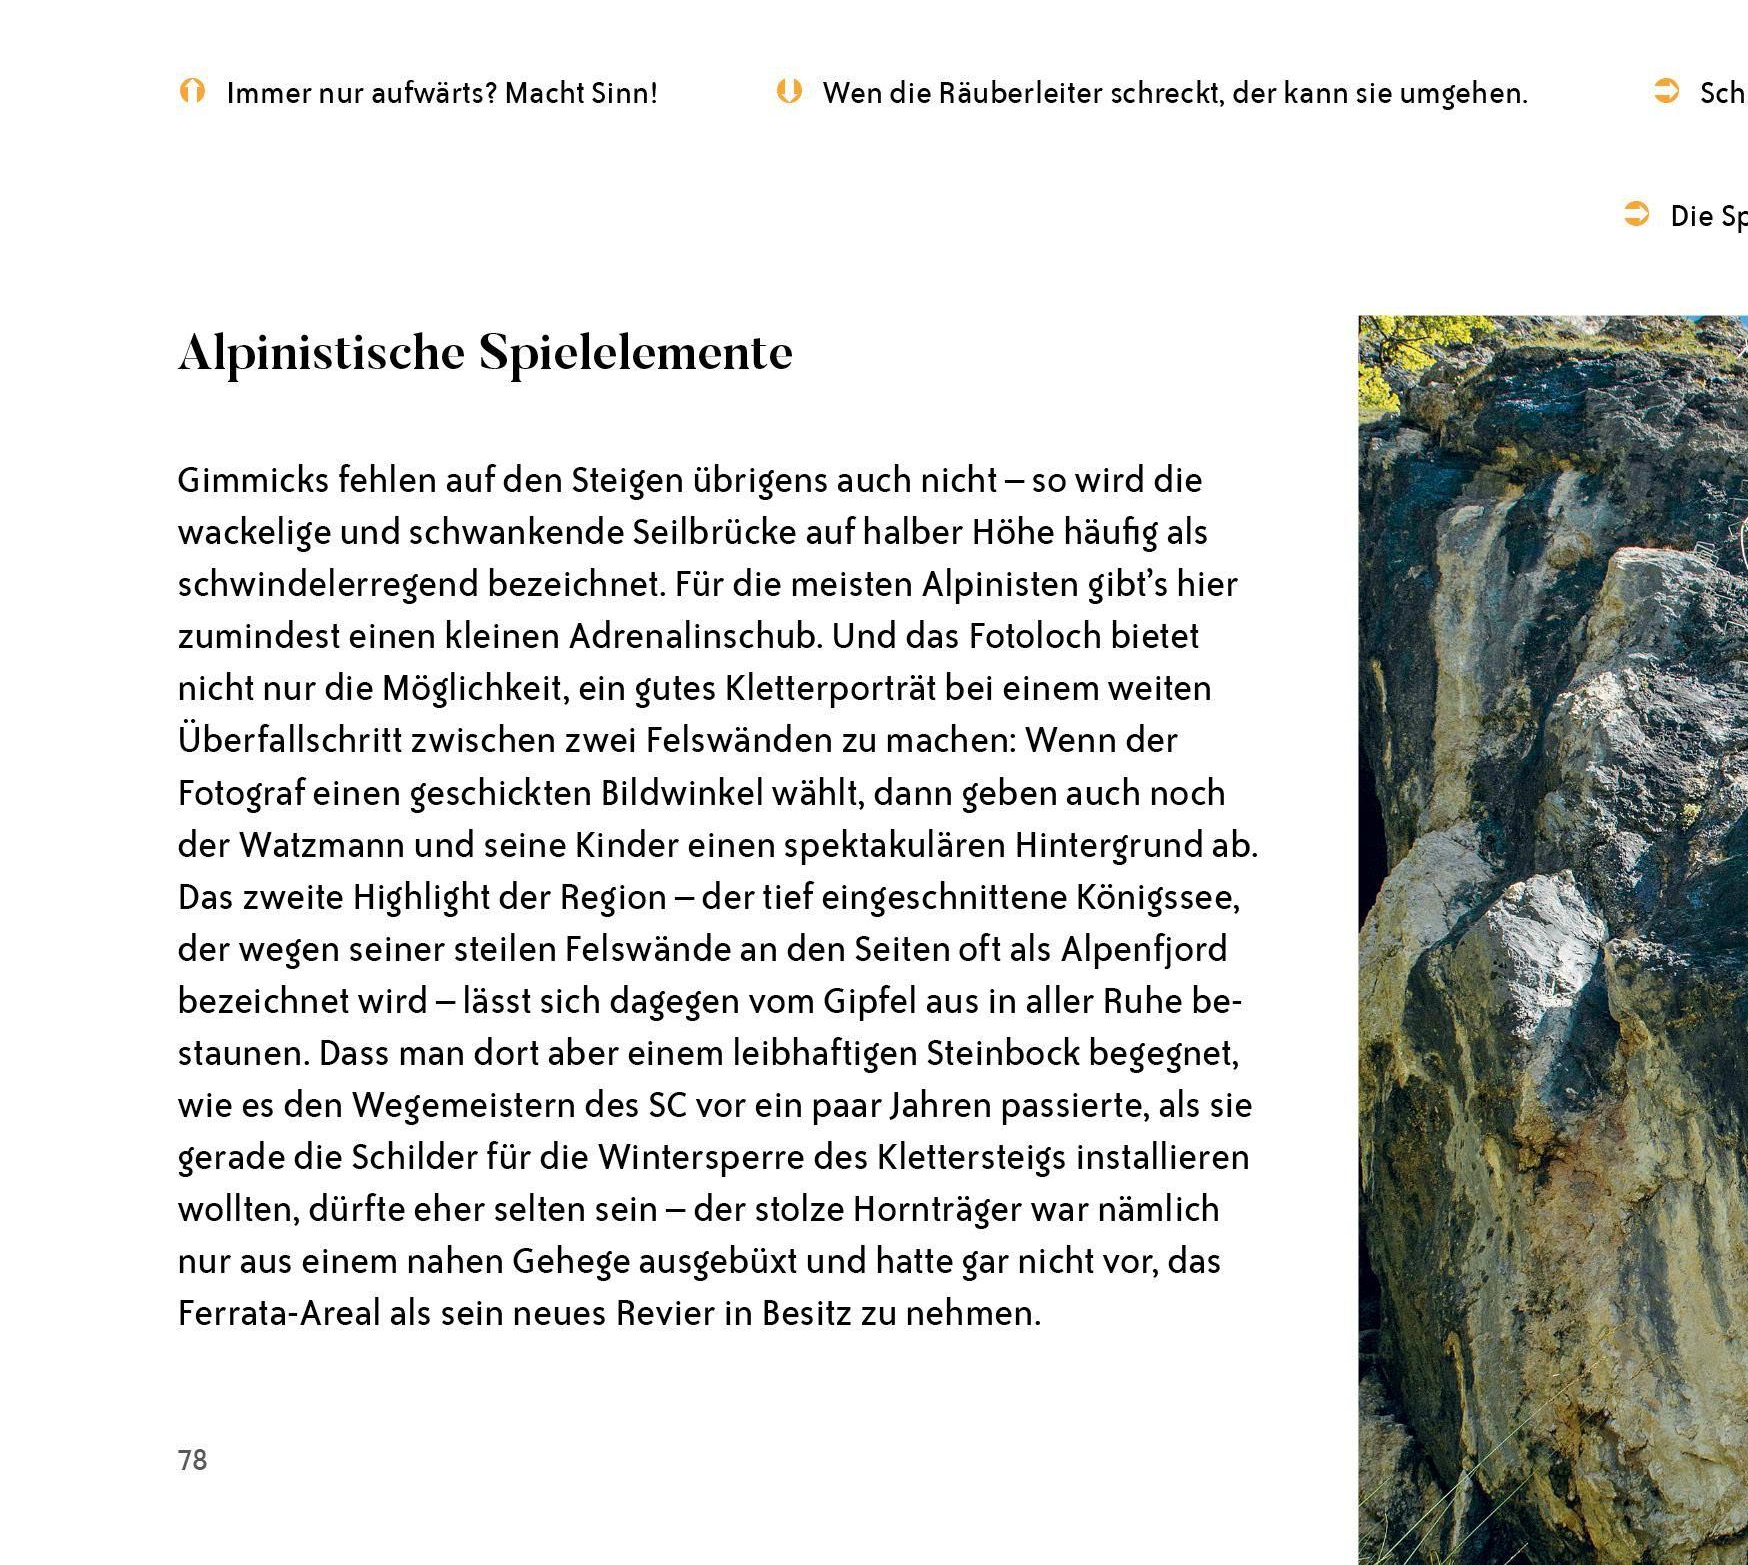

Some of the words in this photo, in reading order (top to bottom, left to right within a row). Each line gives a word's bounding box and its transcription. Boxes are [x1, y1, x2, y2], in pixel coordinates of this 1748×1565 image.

[229, 82, 312, 103] Immer
[320, 88, 364, 103] nur
[372, 80, 496, 103] aufwärts?
[507, 80, 584, 103] Macht
[592, 82, 656, 103] Sinn!
[823, 82, 881, 103] Wen
[890, 80, 931, 103] die
[941, 80, 1103, 103] Räuberleiter
[1112, 80, 1224, 107] schreckt,
[1233, 80, 1276, 103] der
[1285, 80, 1347, 103] kann
[1357, 83, 1392, 103] sie
[1401, 80, 1527, 110] umgehen.
[1673, 205, 1713, 226] Die
[178, 332, 464, 382] Alpinistische
[481, 332, 792, 382] Spielelemente
[178, 516, 331, 552] wackelige
[342, 516, 399, 544] und
[410, 516, 624, 544] schwankende
[634, 516, 796, 544] Seilbrücke
[807, 516, 856, 544] auf
[865, 516, 963, 544] halber
[974, 516, 1054, 544] Höhe
[1066, 516, 1158, 552] häufig
[1168, 516, 1207, 544] als
[179, 620, 339, 648] zumindest
[350, 624, 434, 648] einen
[447, 620, 558, 648] kleinen
[569, 620, 822, 648] Adrenalinschub.
[834, 620, 895, 648] Und
[907, 620, 958, 648] das
[971, 620, 1100, 648] Fotoloch
[1113, 620, 1198, 648] bietet
[180, 672, 253, 700] nicht
[265, 682, 316, 700] nur
[326, 672, 373, 700] die
[384, 672, 569, 708] Möglichkeit,
[580, 676, 624, 700] ein
[636, 676, 715, 708] gutes
[728, 672, 935, 708] Kletterporträt
[947, 672, 991, 700] bei
[1004, 676, 1098, 700] einem
[1108, 676, 1210, 700] weiten
[180, 719, 401, 752] Überfallschritt
[412, 724, 554, 752] zwischen
[566, 728, 634, 752] zwei
[648, 724, 831, 752] Felswänden
[843, 734, 875, 752] zu
[888, 724, 1015, 752] machen:
[1025, 727, 1115, 752] Wenn
[1127, 724, 1178, 752] der
[179, 829, 230, 857] der
[240, 832, 403, 857] Watzmann
[416, 829, 473, 857] und
[485, 833, 566, 857] seine
[577, 829, 679, 857] Kinder
[689, 833, 774, 857] einen
[785, 829, 1004, 865] spektakulären
[1017, 829, 1202, 865] Hintergrund
[1213, 829, 1257, 857] ab.
[179, 933, 230, 961] der
[239, 939, 338, 969] wegen
[350, 937, 445, 961] seiner
[455, 933, 555, 961] steilen
[567, 933, 730, 961] Felswände
[741, 943, 776, 961] an
[788, 933, 844, 961] den
[856, 936, 949, 961] Seiten
[960, 933, 1000, 961] oft
[1011, 933, 1050, 961] als
[1061, 933, 1226, 969] Alpenfjord
[179, 1041, 309, 1065] staunen.
[321, 1040, 388, 1065] Dass
[401, 1047, 463, 1065] man
[475, 1037, 538, 1065] dort
[549, 1037, 619, 1065] aber
[629, 1041, 722, 1065] einem
[735, 1037, 916, 1073] leibhaftigen
[928, 1037, 1079, 1065] Steinbock
[1091, 1037, 1238, 1073] begegnet,
[178, 1093, 232, 1117] wie
[243, 1099, 273, 1117] es
[285, 1089, 341, 1117] den
[352, 1092, 574, 1125] Wegemeistern
[586, 1089, 638, 1117] des
[650, 1092, 686, 1117] SC
[696, 1099, 746, 1117] vor
[756, 1093, 801, 1117] ein
[814, 1099, 882, 1125] paar
[890, 1089, 990, 1120] Jahren
[1003, 1093, 1149, 1125] passierte,
[1160, 1089, 1199, 1117] als
[1211, 1093, 1252, 1117] sie
[179, 1141, 284, 1177] gerade
[295, 1141, 342, 1169] die
[353, 1141, 478, 1169] Schilder
[487, 1141, 531, 1169] für
[541, 1141, 588, 1169] die
[598, 1144, 804, 1177] Wintersperre
[815, 1141, 867, 1169] des
[879, 1141, 1065, 1177] Klettersteigs
[1078, 1141, 1248, 1169] installieren
[180, 1297, 378, 1325] Ferrata-Areal
[391, 1297, 430, 1325] als
[442, 1301, 502, 1325] sein
[515, 1307, 605, 1325] neues
[618, 1300, 715, 1325] Revier
[726, 1301, 751, 1325] in
[764, 1300, 851, 1325] Besitz
[862, 1307, 895, 1325] zu
[908, 1297, 1040, 1325] nehmen.
[179, 1449, 206, 1470] 78
